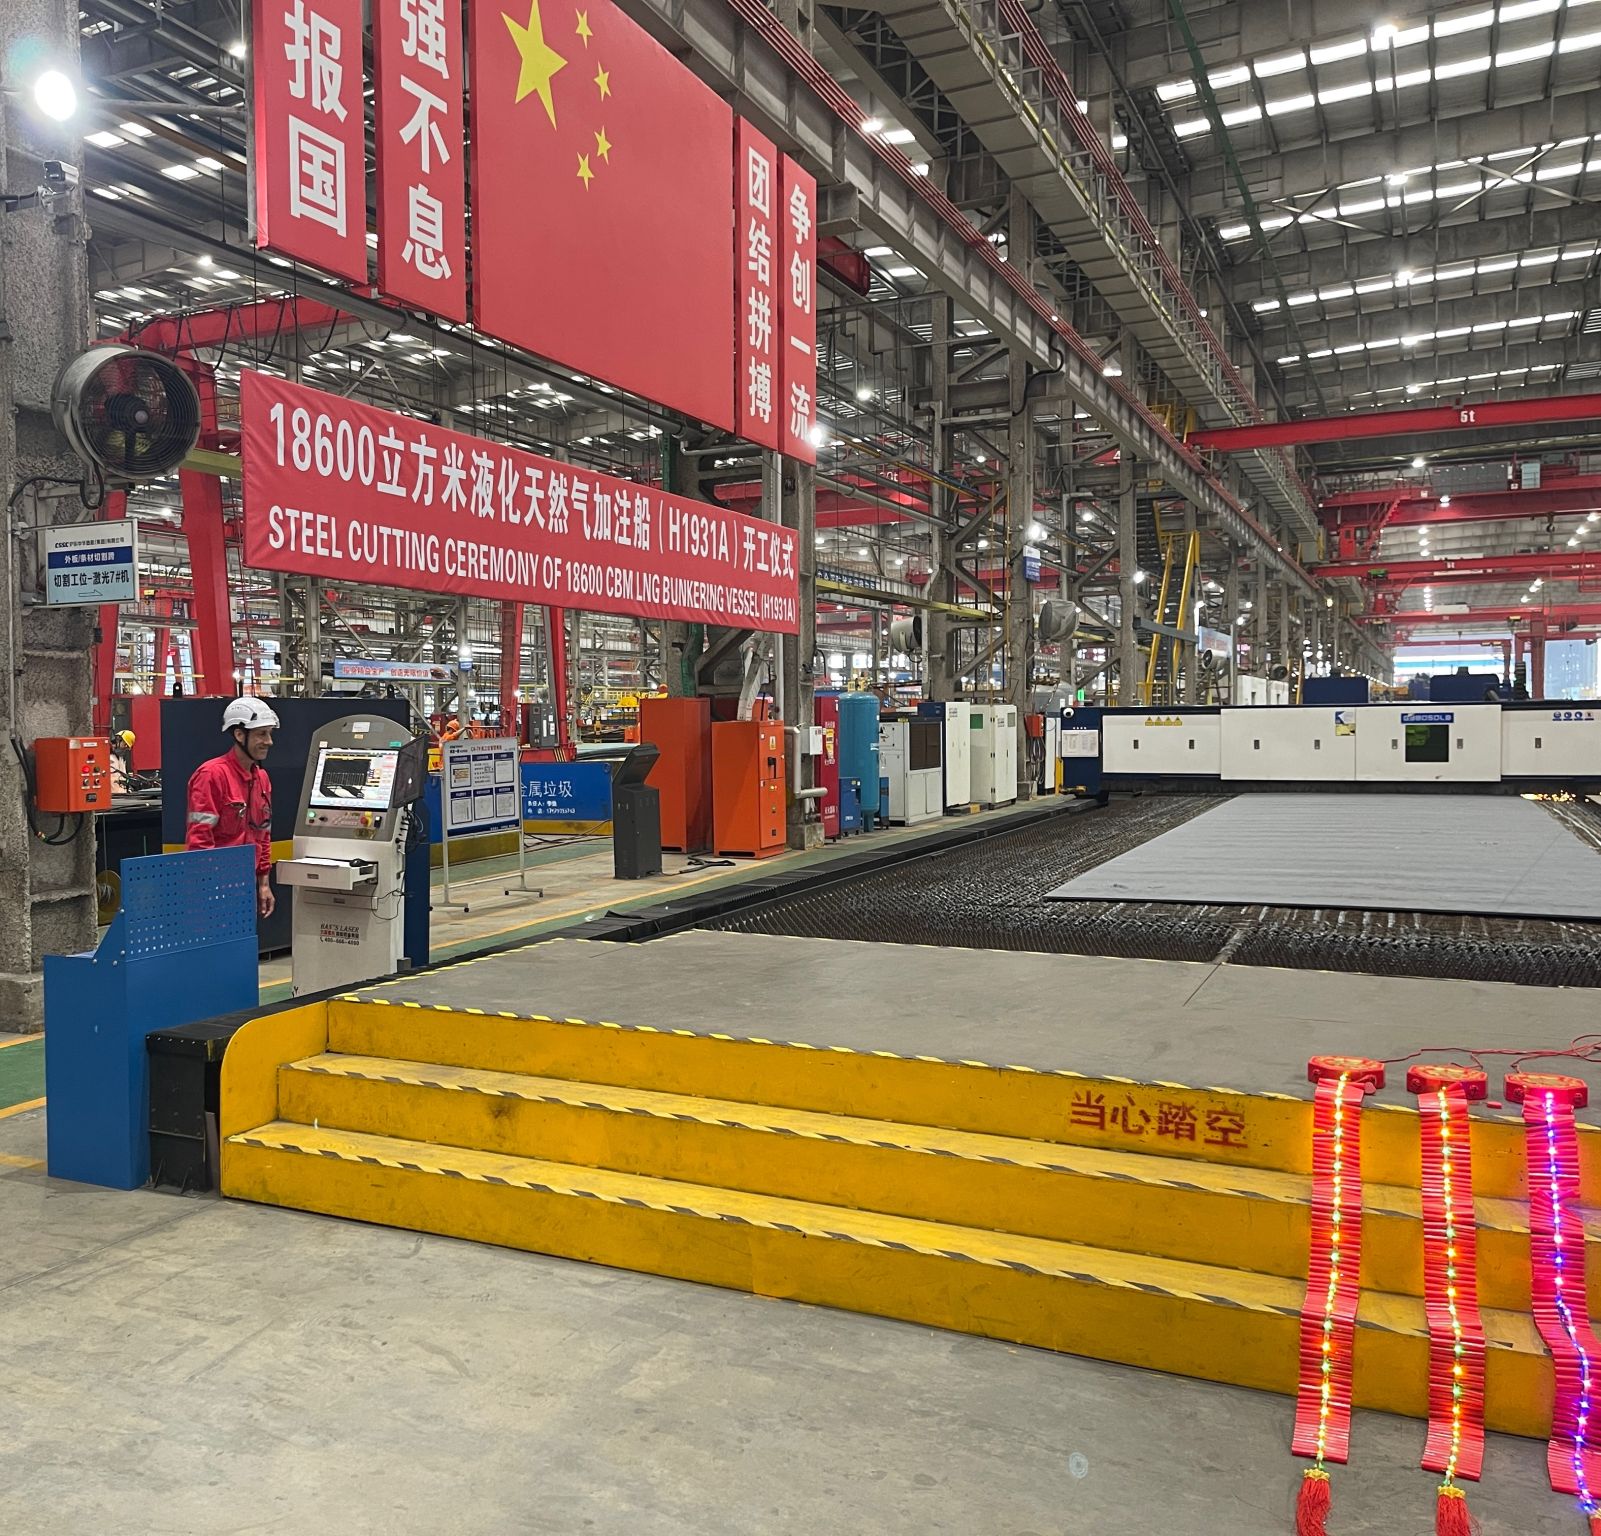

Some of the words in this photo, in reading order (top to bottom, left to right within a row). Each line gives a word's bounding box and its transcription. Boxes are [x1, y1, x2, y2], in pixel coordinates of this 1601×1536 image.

[284, 0, 348, 238] 报国
[748, 145, 772, 424] 团结拼搏
[790, 184, 812, 441] 争创一流
[1460, 410, 1475, 423] 5t
[54, 569, 130, 588] 切割工位-激光7#机
[268, 505, 343, 559] STEEL
[349, 520, 440, 574] CUTTING
[444, 537, 539, 587] CEREMONY
[542, 555, 562, 590] OF
[565, 561, 603, 596] 18600
[605, 566, 633, 600] CBM
[636, 571, 660, 604] LNG
[662, 575, 724, 613] BUNKERING
[725, 586, 760, 617] VESSEL
[761, 592, 796, 625] (H1931A)
[1070, 1090, 1248, 1149] 当心踏空
